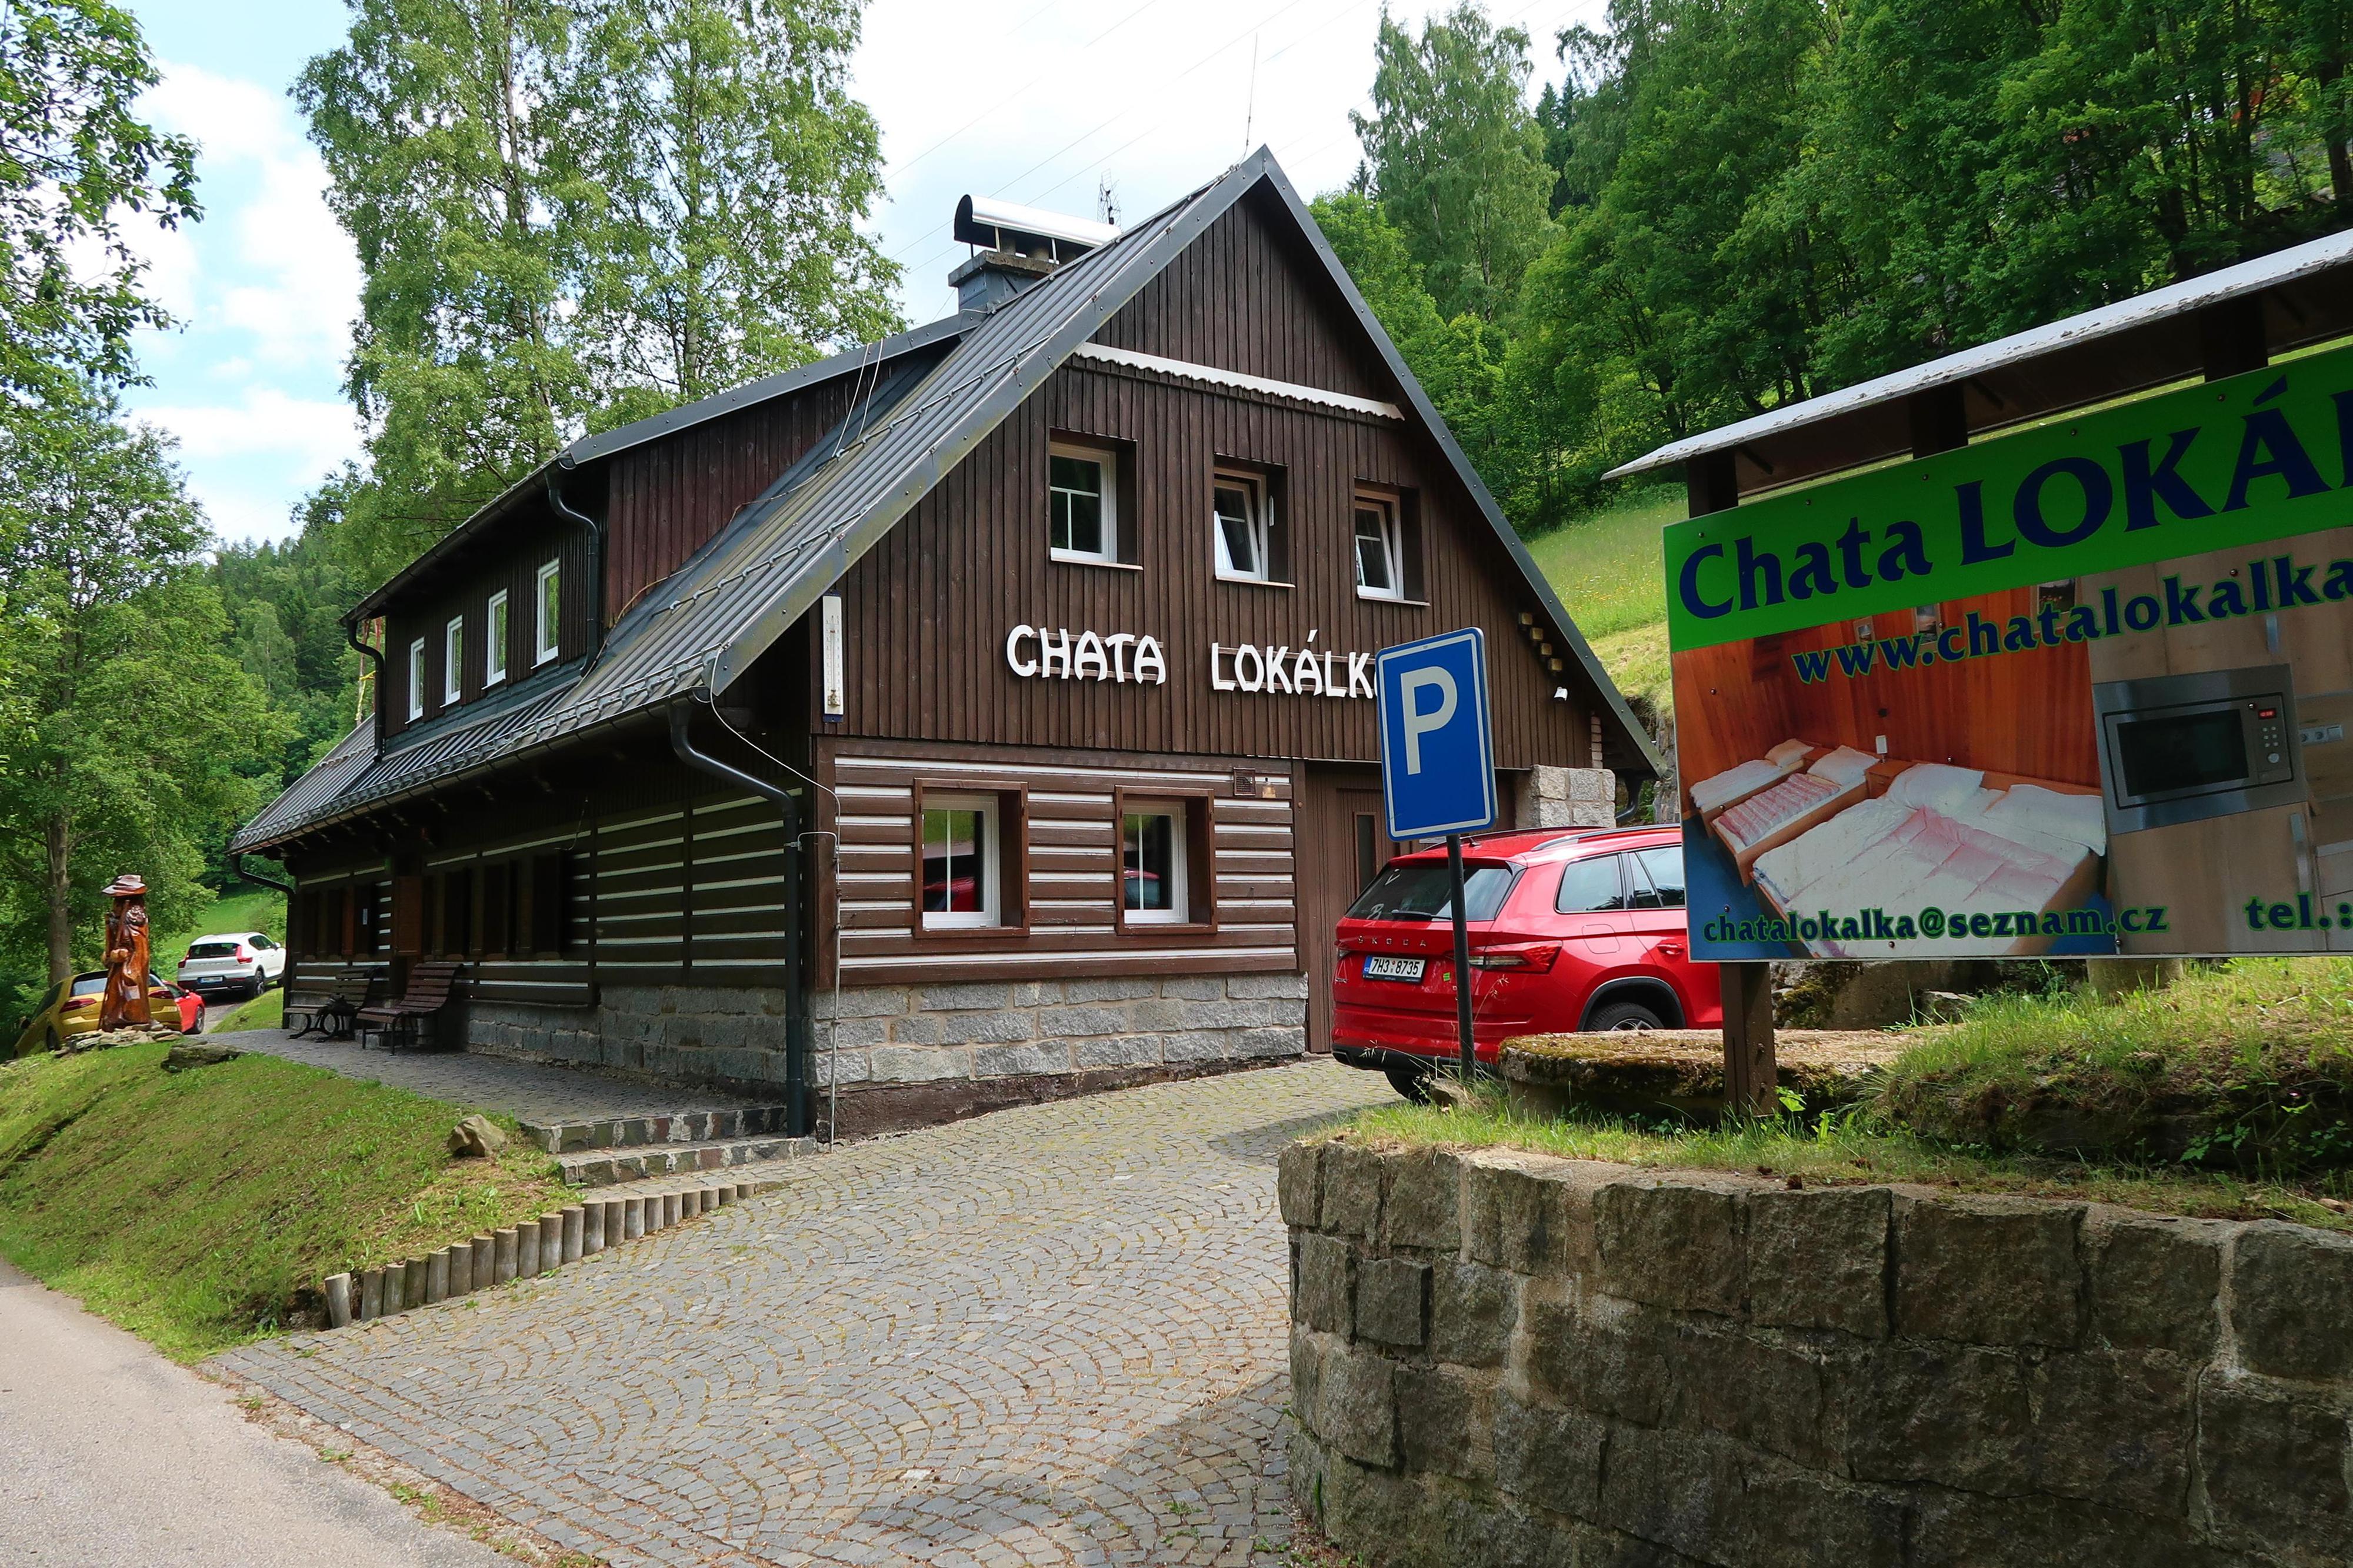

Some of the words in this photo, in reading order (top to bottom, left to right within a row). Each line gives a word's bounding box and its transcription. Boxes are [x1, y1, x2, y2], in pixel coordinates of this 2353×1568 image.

[1679, 516, 1934, 619] Chata
[1006, 624, 1166, 685] CHATA
[1211, 629, 1378, 699] LOKÁLK
[1400, 666, 1458, 775] P
[1704, 906, 2170, 942] chatalokalka@seznam.cz
[2243, 892, 2353, 931] tel.:
[1371, 959, 1390, 973] 7H3
[1395, 960, 1420, 975] 8735
